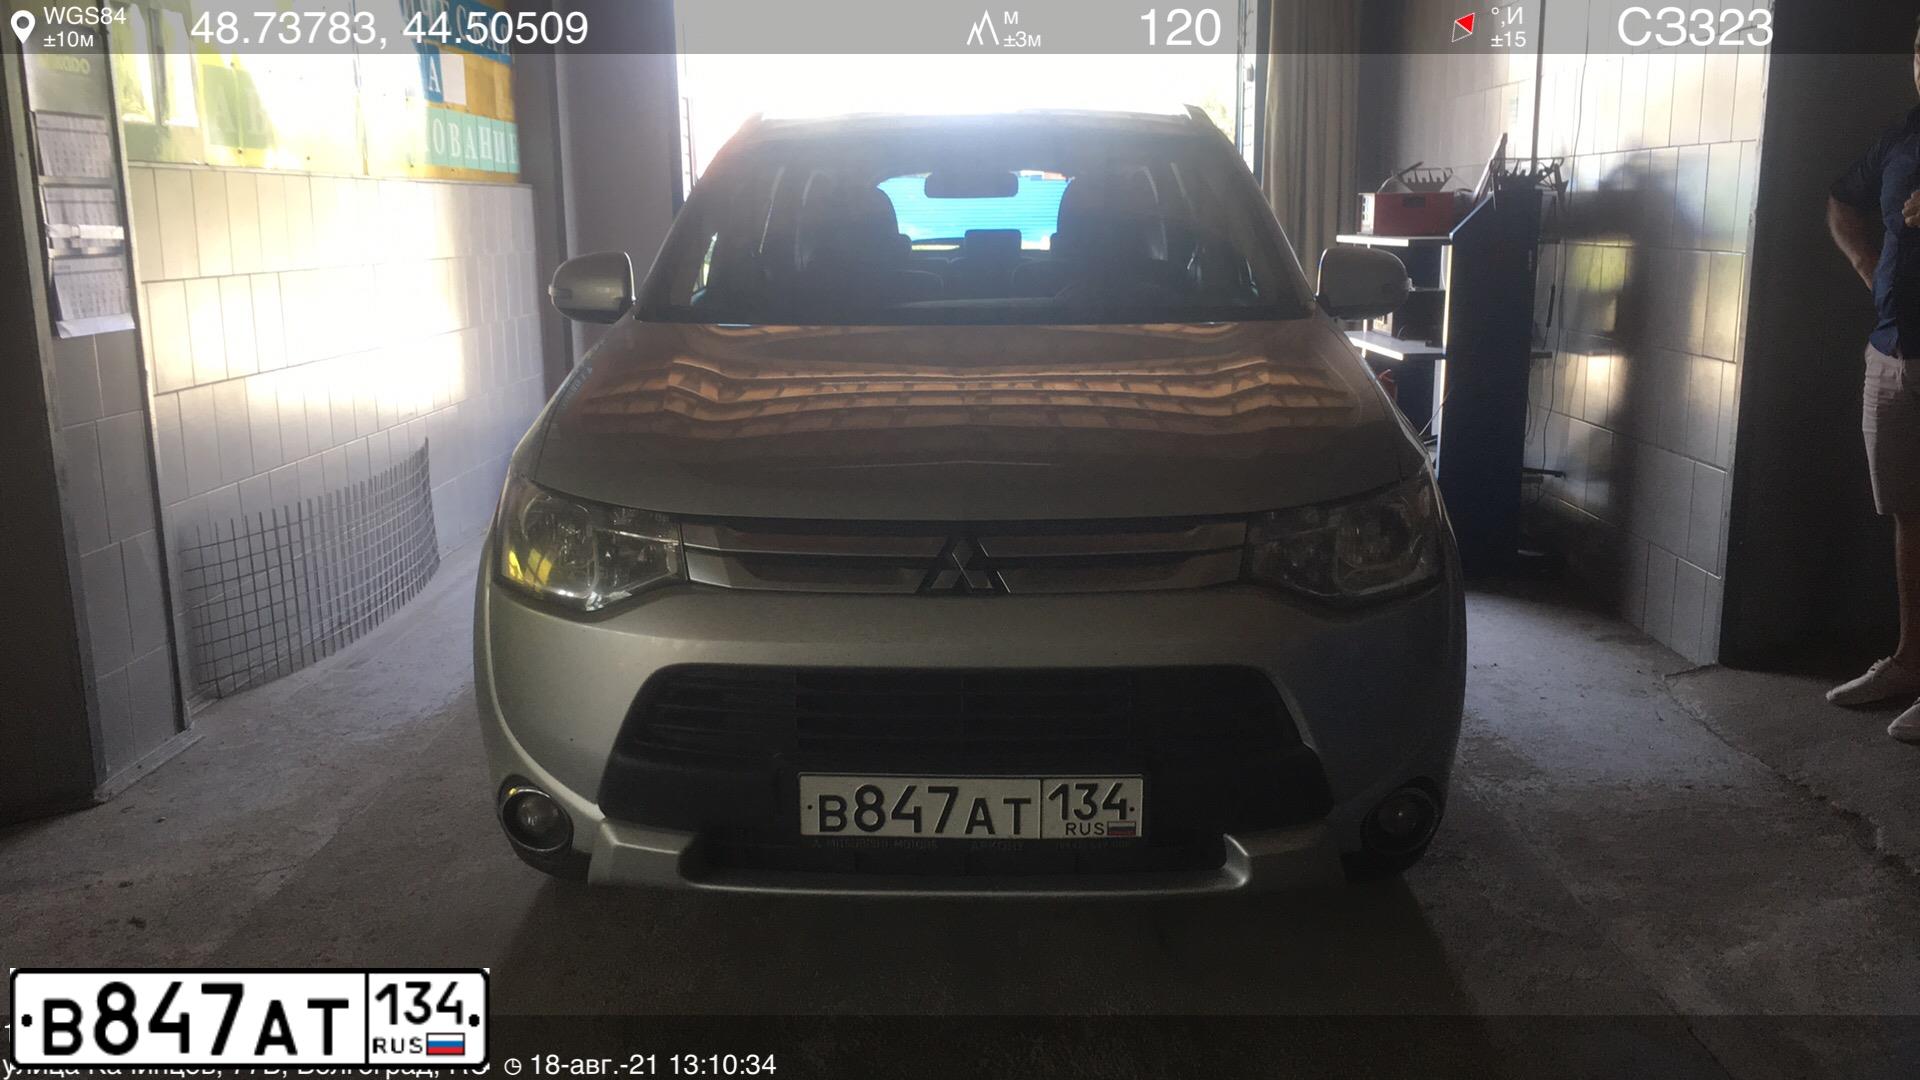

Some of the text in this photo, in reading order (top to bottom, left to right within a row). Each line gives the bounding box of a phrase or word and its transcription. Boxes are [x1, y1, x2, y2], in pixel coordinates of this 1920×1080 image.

[817, 782, 1127, 836] В847АТ 134
[1064, 821, 1105, 836] RUS
